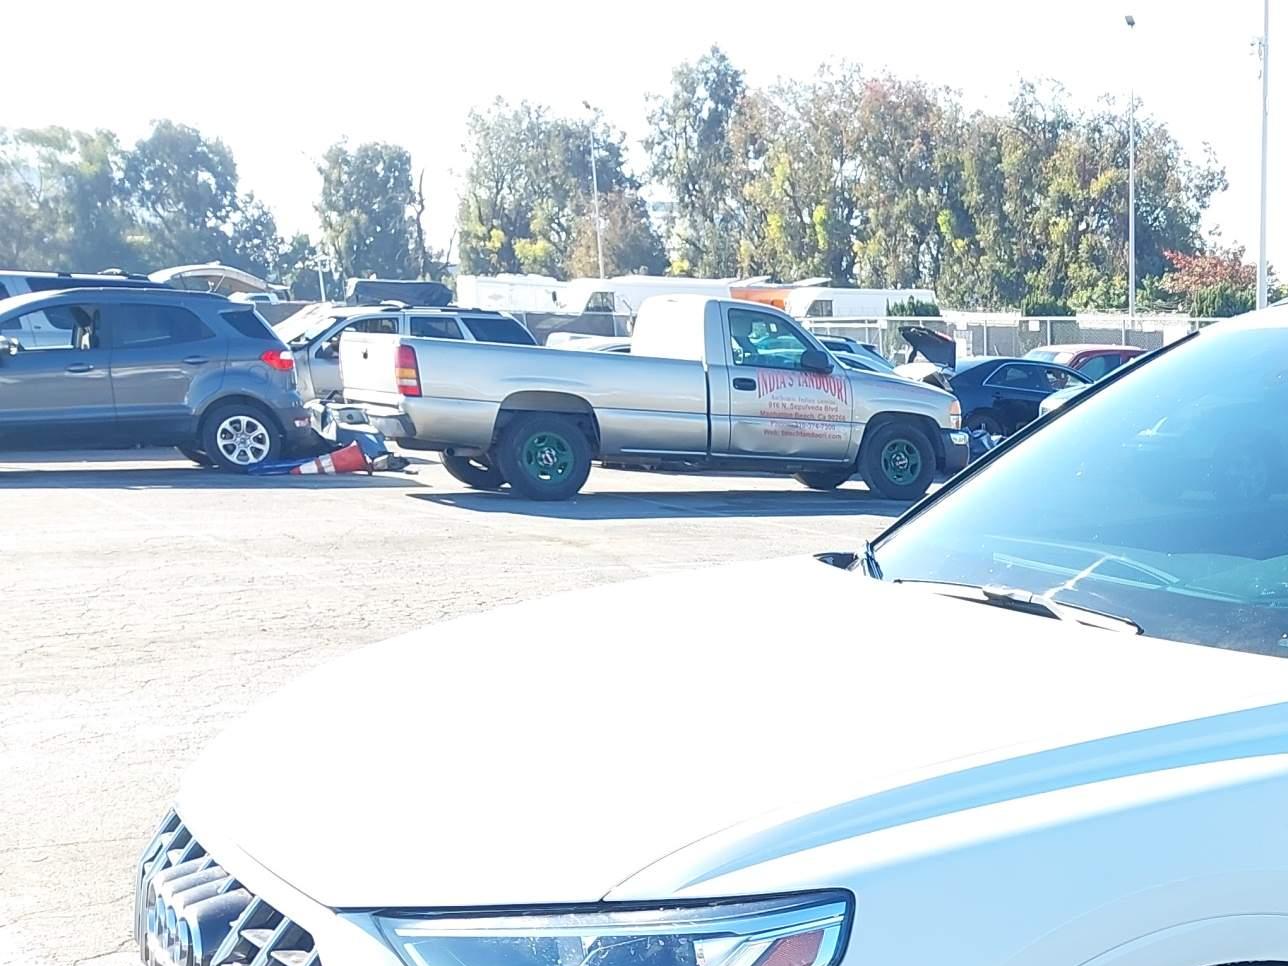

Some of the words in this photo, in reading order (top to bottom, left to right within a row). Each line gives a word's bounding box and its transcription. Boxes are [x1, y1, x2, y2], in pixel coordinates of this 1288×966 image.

[757, 369, 794, 398] INDIA'S
[798, 371, 848, 405] TANDOORI
[790, 403, 823, 412] Sepulveda
[824, 405, 839, 413] Blvd
